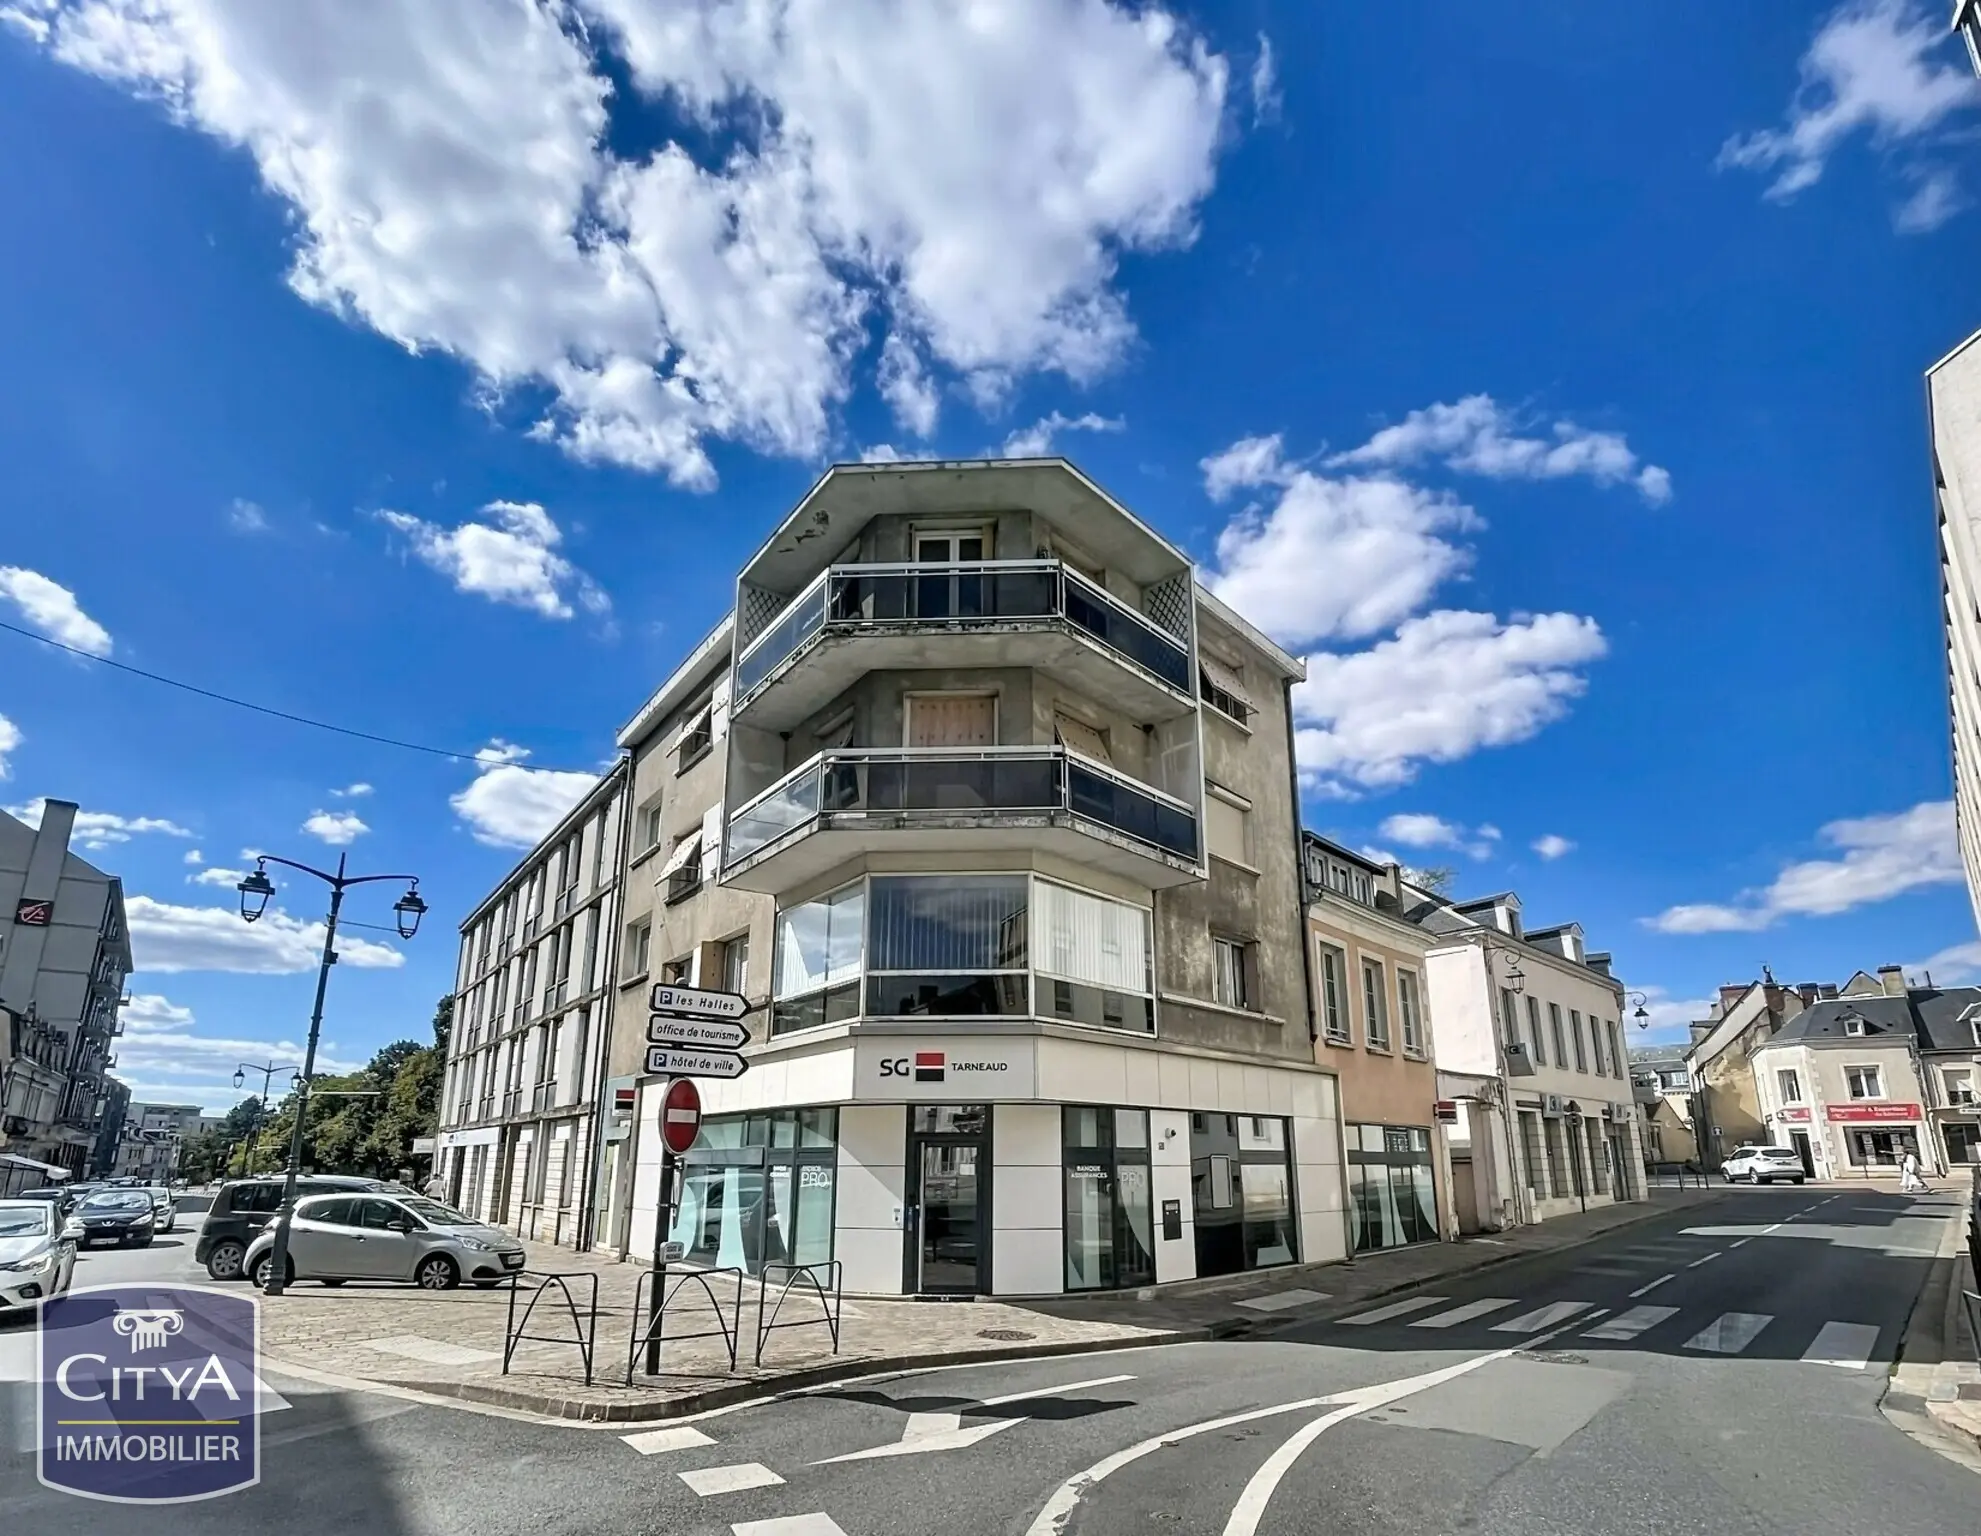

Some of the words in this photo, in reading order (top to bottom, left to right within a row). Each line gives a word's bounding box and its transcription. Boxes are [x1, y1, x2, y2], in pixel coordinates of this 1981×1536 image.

[661, 992, 671, 1004] P
[676, 995, 693, 1006] les
[699, 998, 734, 1011] Halles
[656, 1024, 685, 1036] office
[687, 1027, 699, 1038] de
[701, 1029, 740, 1041] tourisme
[655, 1054, 666, 1067] P
[670, 1056, 698, 1068] hôtel
[699, 1058, 711, 1070] de
[714, 1060, 734, 1071] ville
[879, 1058, 910, 1077] SG
[951, 1062, 1008, 1072] TARNEAUD
